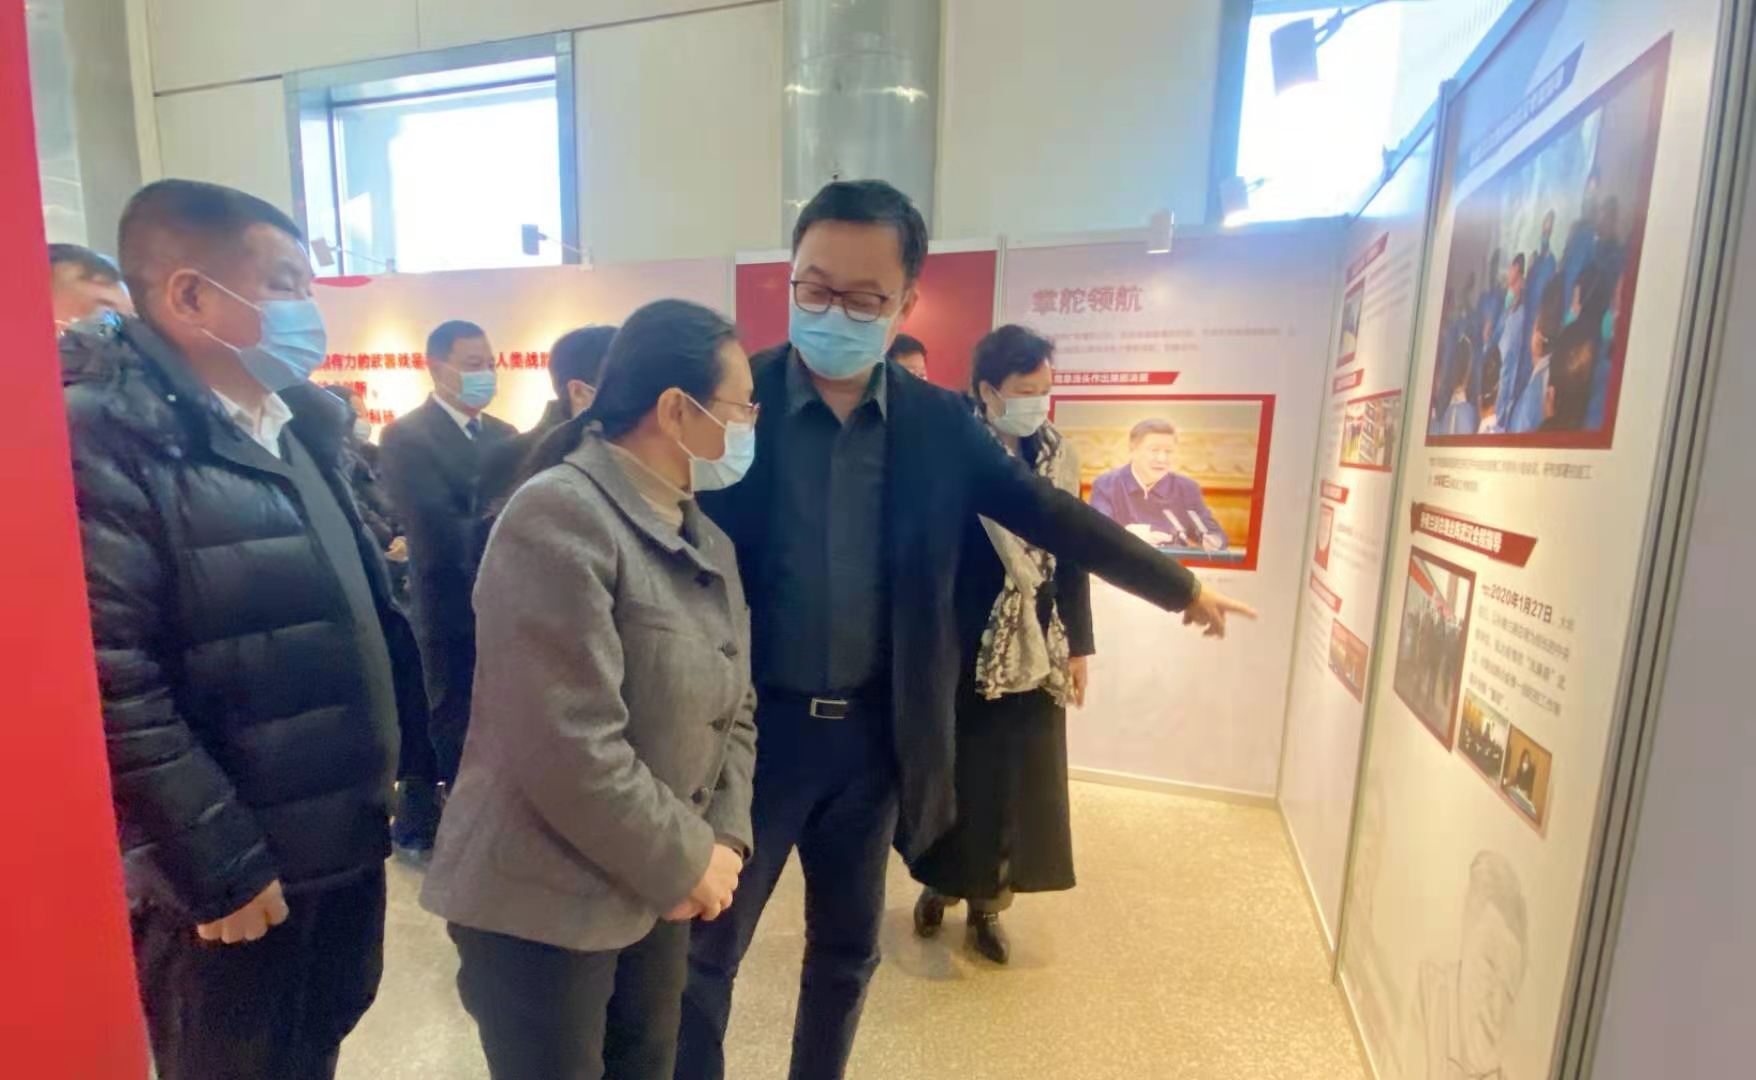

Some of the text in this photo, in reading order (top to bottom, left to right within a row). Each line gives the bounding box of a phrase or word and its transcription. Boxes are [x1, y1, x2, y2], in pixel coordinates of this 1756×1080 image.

[1032, 285, 1143, 315] 掌舵领航
[320, 351, 427, 370] 有力的武器就是
